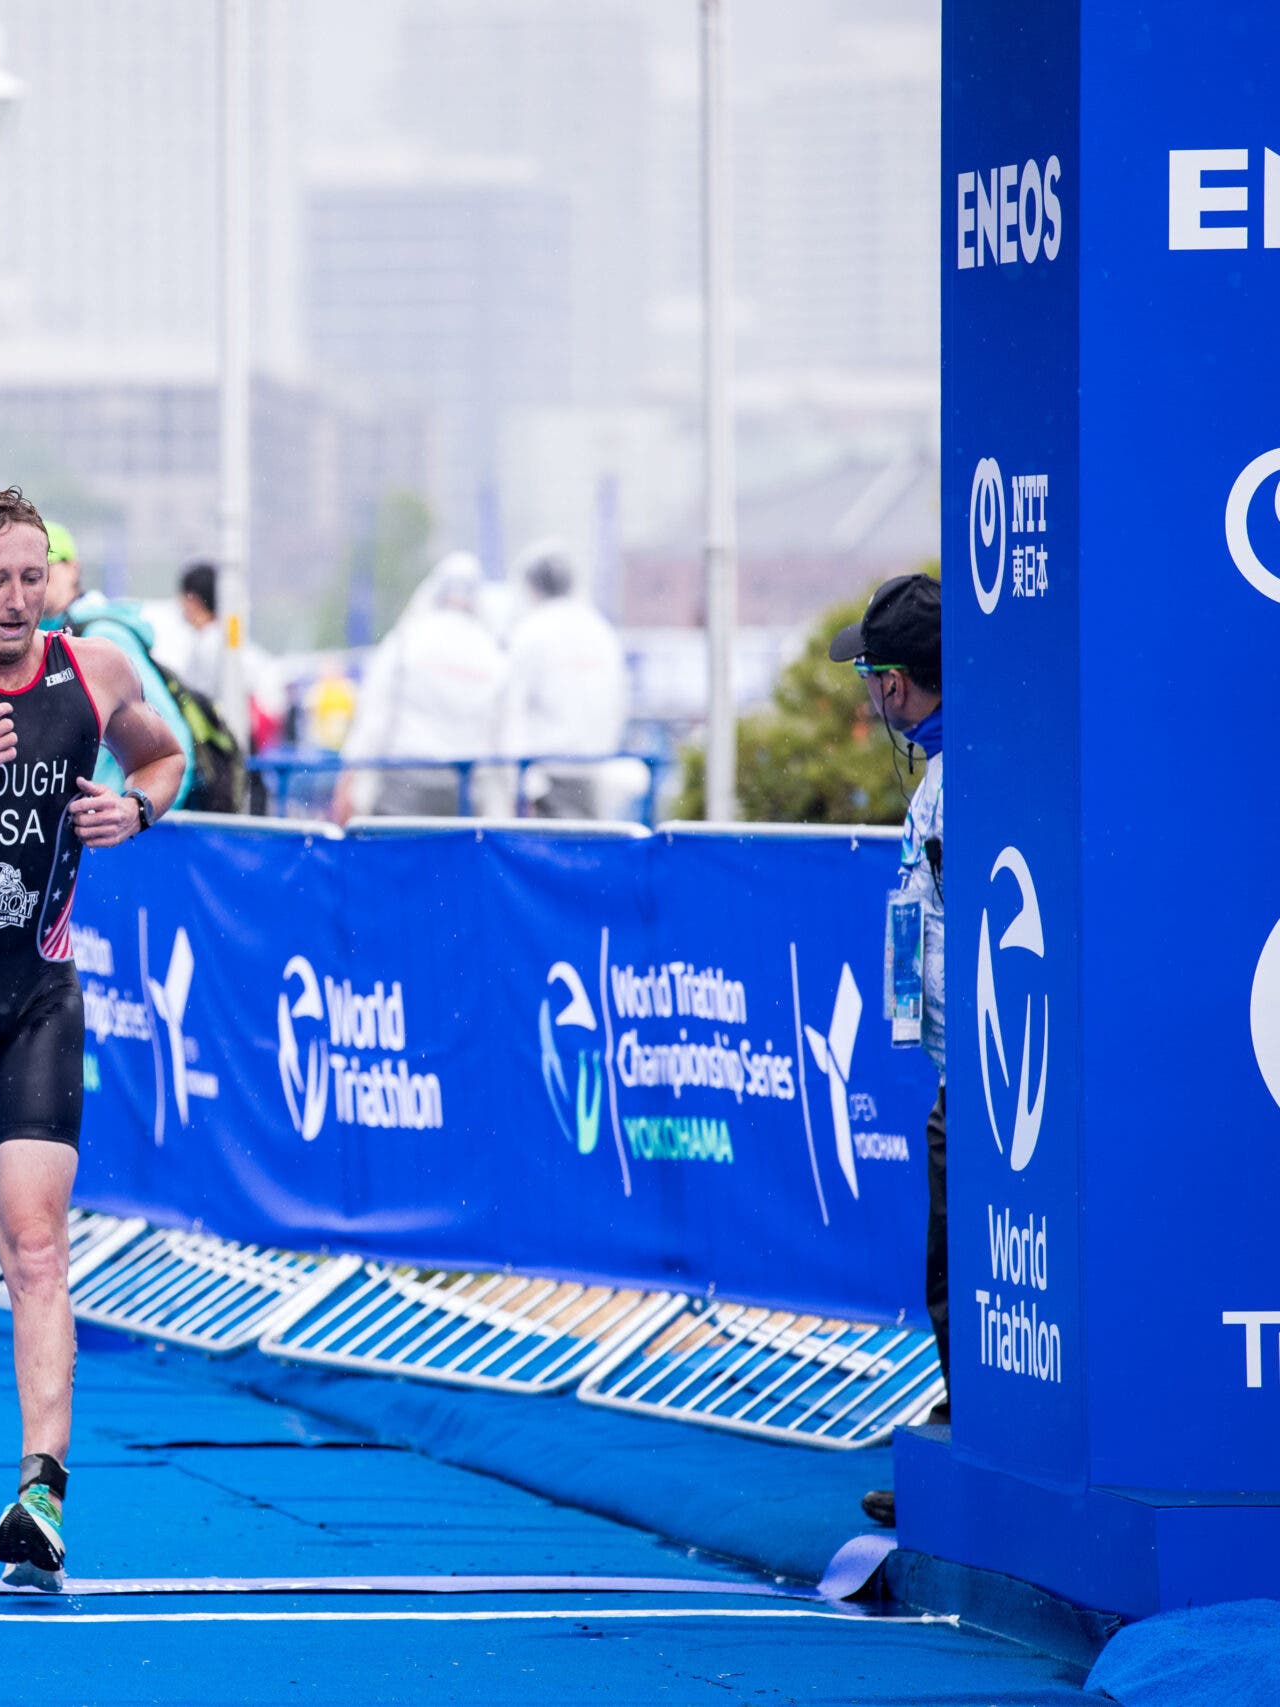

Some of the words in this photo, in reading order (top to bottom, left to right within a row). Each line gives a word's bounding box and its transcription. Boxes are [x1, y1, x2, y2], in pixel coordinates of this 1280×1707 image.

[957, 154, 1062, 270] ENEOS
[1169, 147, 1280, 251] E
[1012, 474, 1049, 533] NTT
[1012, 543, 1049, 598] 東日本
[323, 974, 406, 1052] World
[610, 963, 673, 1019] World
[668, 960, 748, 1025] Triathlon
[329, 1052, 444, 1131] Triathlon
[616, 1027, 745, 1105] Championship
[739, 1039, 796, 1101] Series
[622, 1115, 735, 1165] YOKOHAMA
[852, 1131, 911, 1162] YOKOHAMA
[987, 1204, 1048, 1291] World
[975, 1289, 1062, 1384] Triathlon
[1222, 1311, 1280, 1389] T
